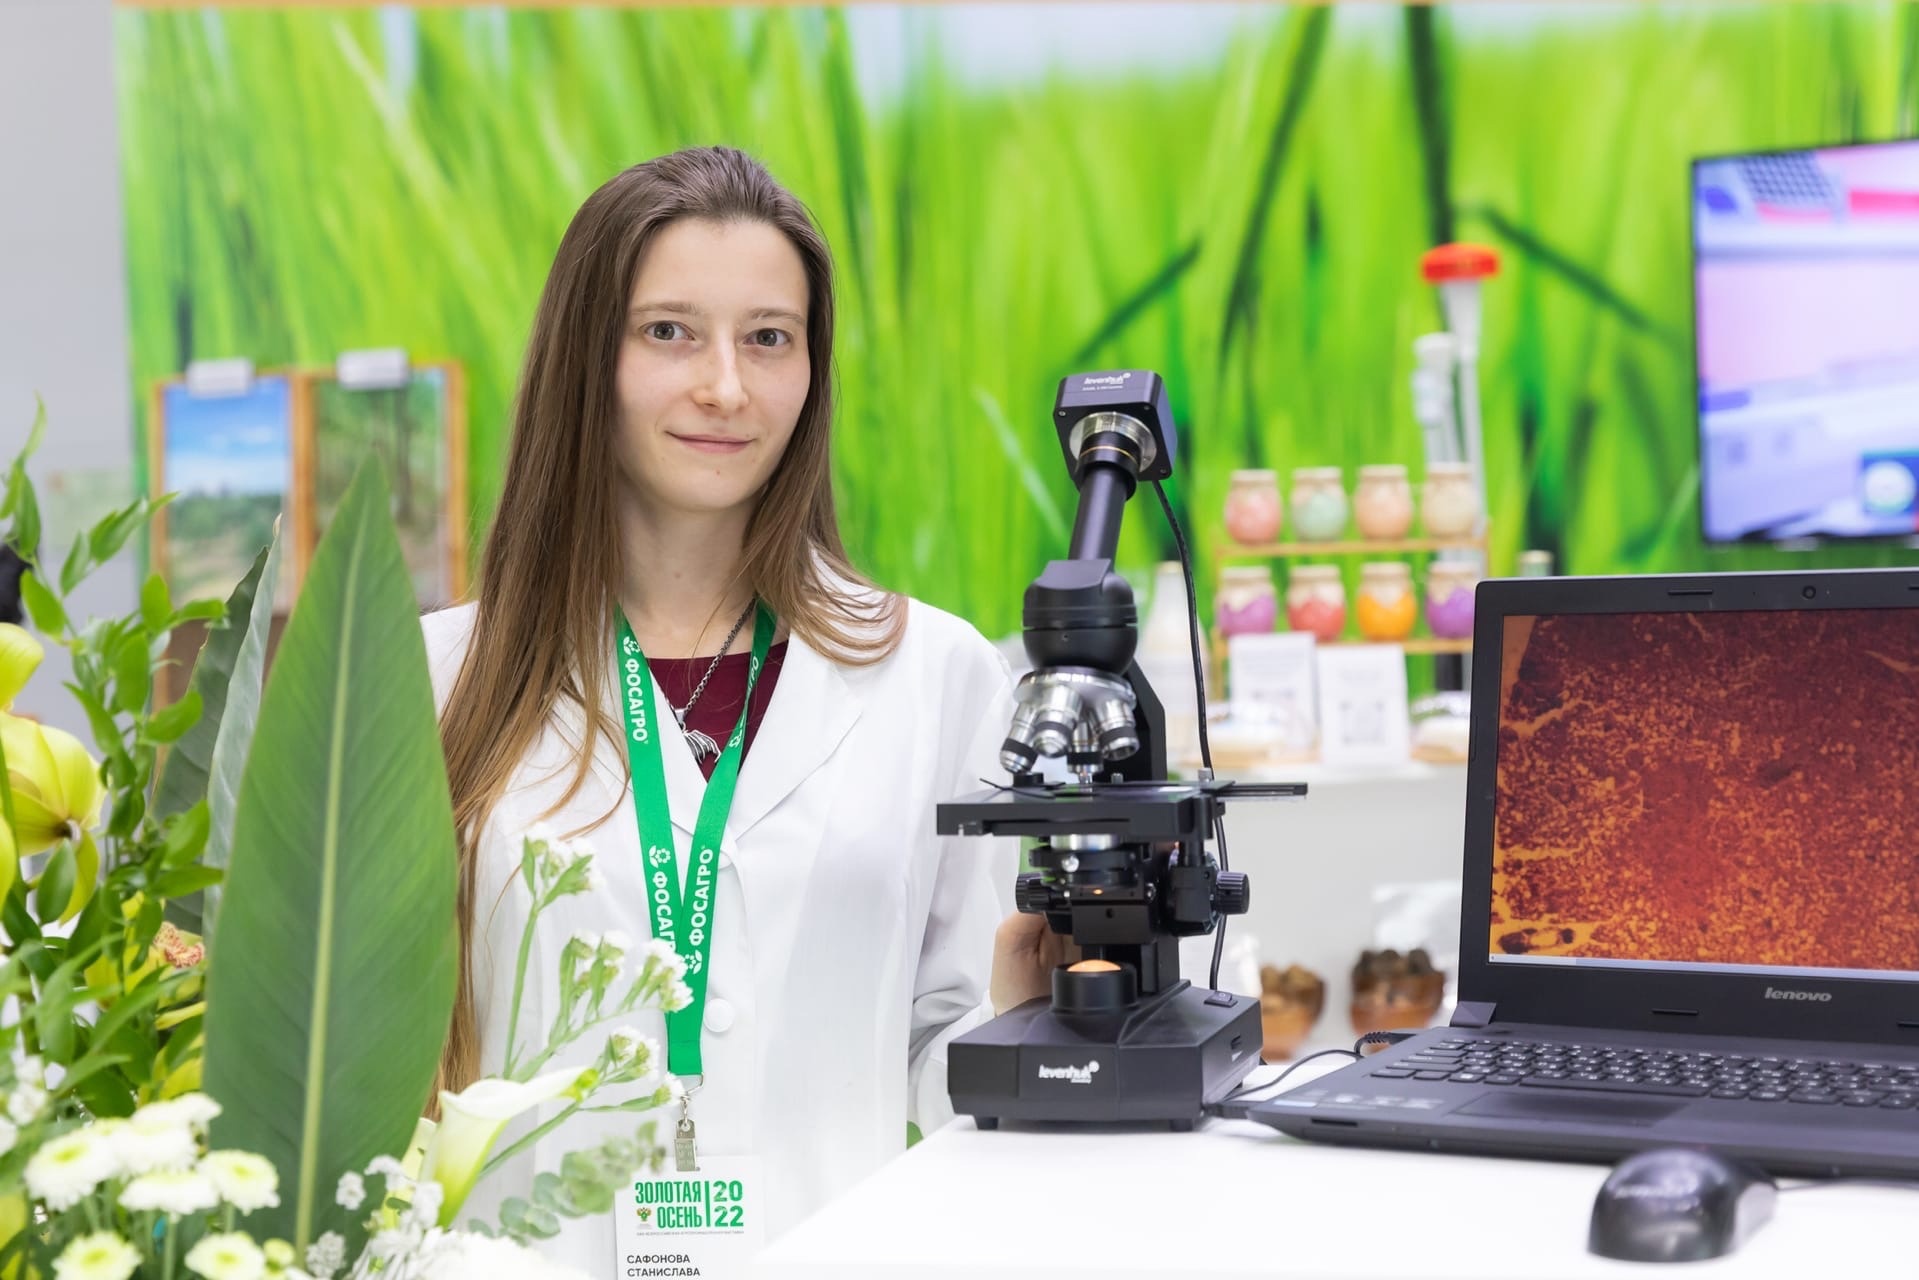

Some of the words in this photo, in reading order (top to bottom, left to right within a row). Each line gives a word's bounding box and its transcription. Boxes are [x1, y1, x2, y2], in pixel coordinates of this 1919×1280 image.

[625, 658, 648, 742] ФОСАГРО
[689, 848, 714, 947] ФОСАГРО
[1764, 986, 1833, 1002] lenovo
[635, 1181, 702, 1204] ЗОЛОТАЯ
[713, 1180, 743, 1202] 20
[657, 1206, 703, 1228] ОСЕНЬ
[714, 1205, 744, 1227] 22
[626, 1254, 691, 1264] САФОНОВА
[627, 1267, 701, 1277] СТАНИСЛАВА
